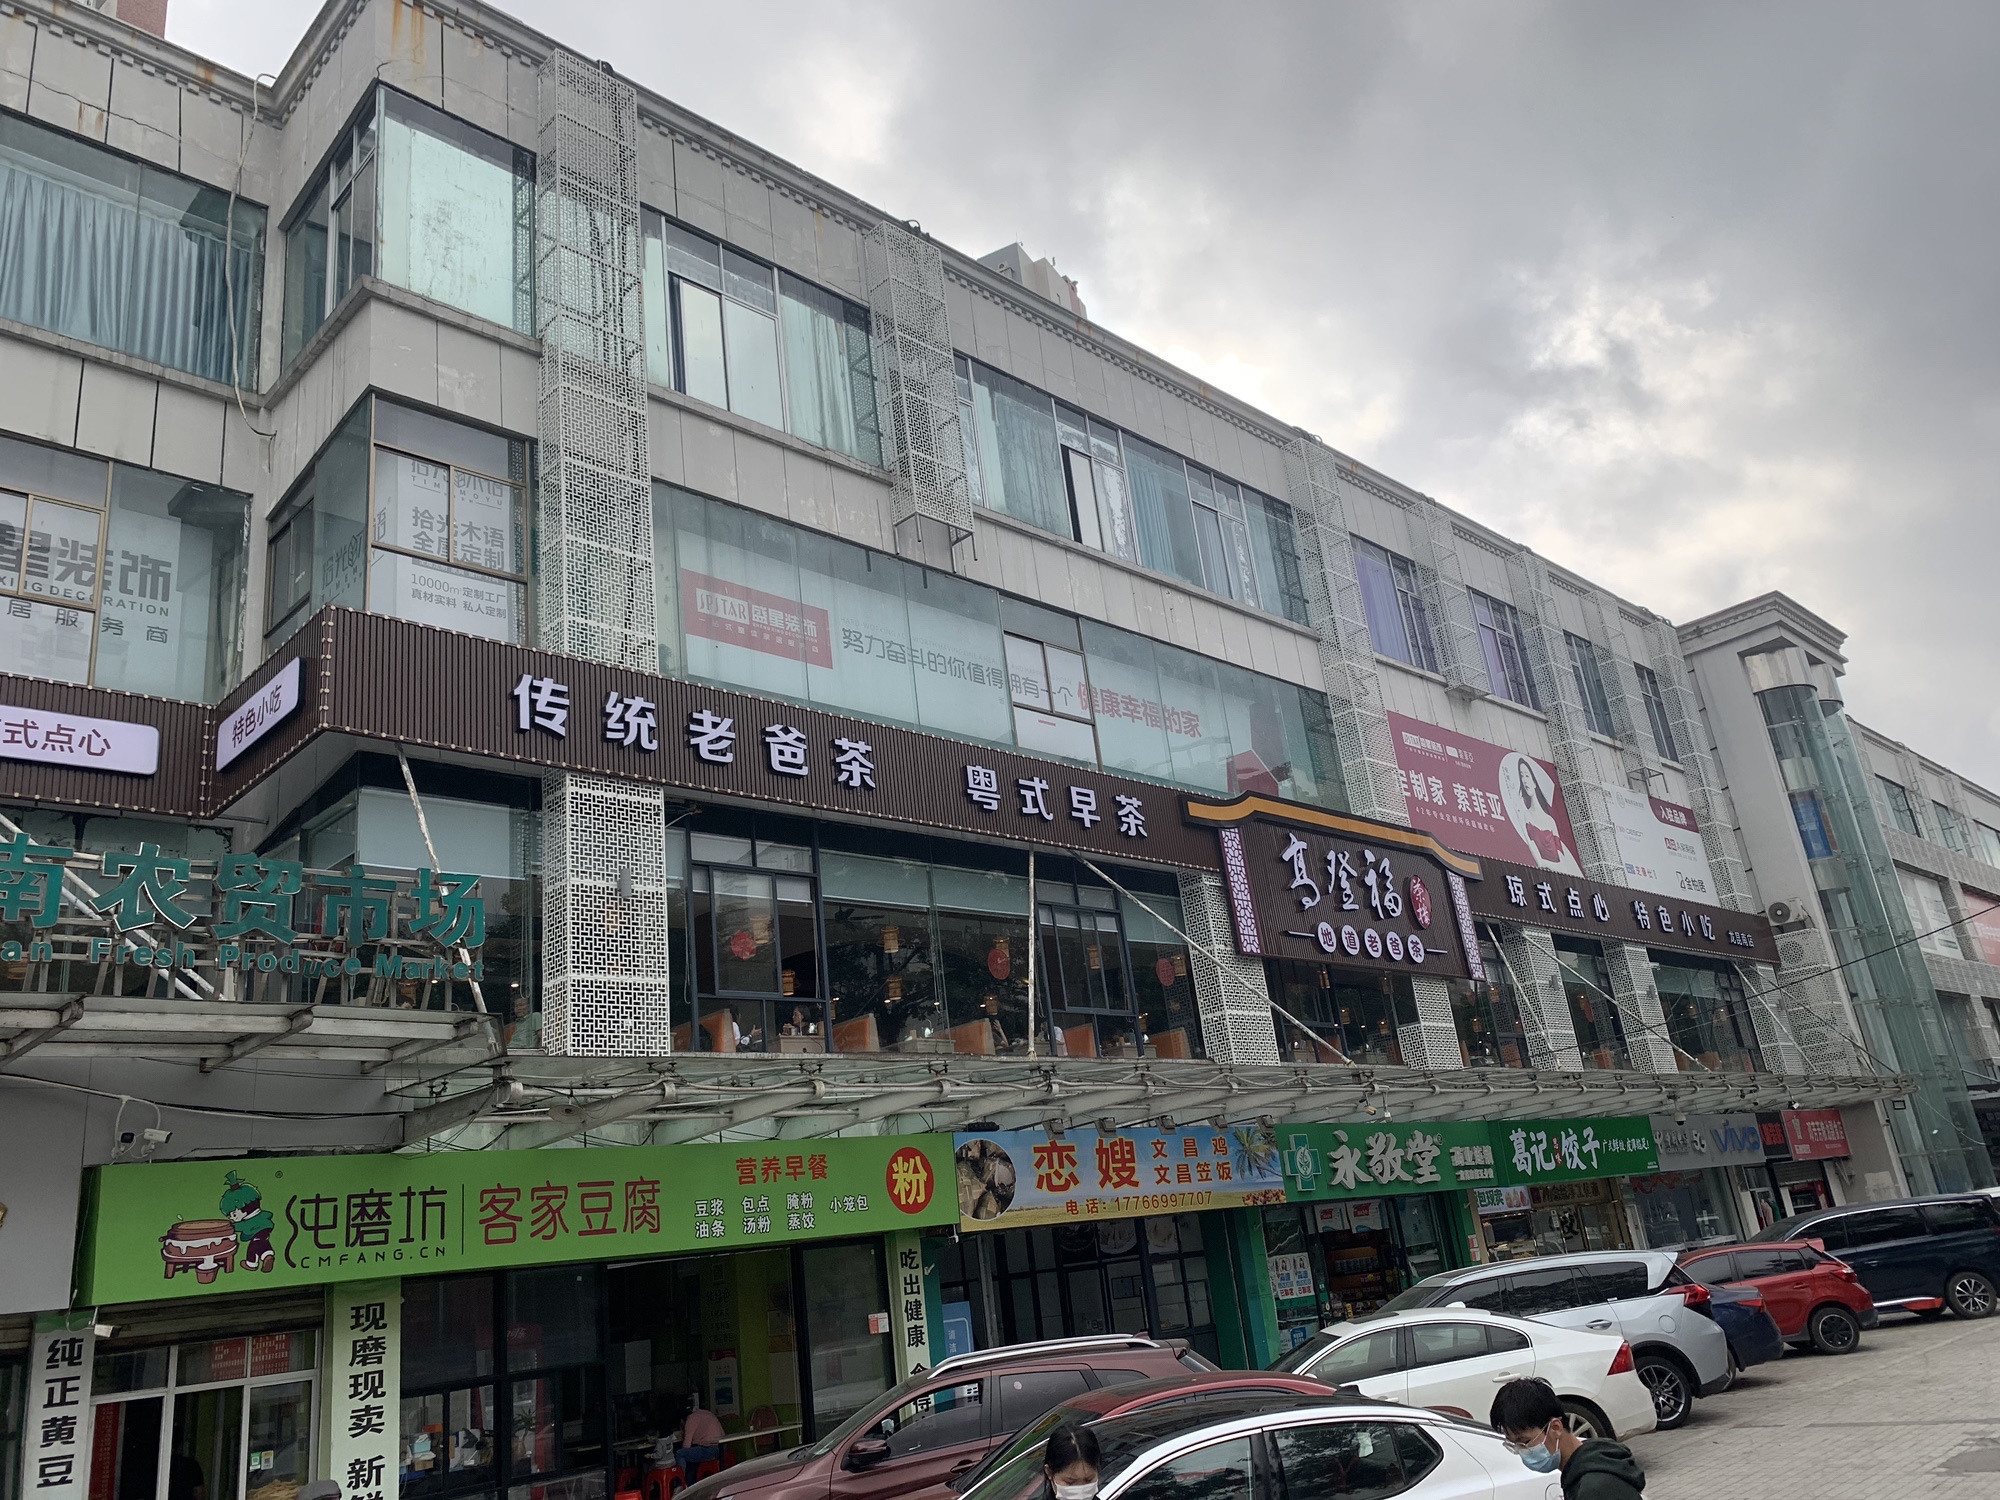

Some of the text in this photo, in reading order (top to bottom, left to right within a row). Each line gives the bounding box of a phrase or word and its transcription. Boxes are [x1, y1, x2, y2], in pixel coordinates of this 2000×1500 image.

[411, 587, 507, 620] 真材实料 私人定制
[751, 603, 818, 638] 盛星装饰
[231, 684, 283, 748] 特色小吃
[0, 718, 111, 758] 式点心
[513, 673, 1148, 838] 传统老爸茶 粤式早茶
[1452, 782, 1506, 822] 索菲亚
[1659, 805, 1688, 827] 入驻品牌
[0, 831, 487, 949] 南农贸市场
[1505, 873, 1611, 922] 琼式点心
[1633, 899, 1716, 942] 特色小吃
[89, 937, 196, 970] Fresh
[219, 944, 361, 976] Produce
[375, 953, 485, 981] Market
[1319, 925, 1424, 960] 地道老爸茶
[1032, 1136, 1140, 1194] 恋嫂
[1150, 1136, 1229, 1160] 文昌鸡
[1326, 1129, 1442, 1190] 永敬堂
[735, 1153, 829, 1186] 营养早餐
[891, 1155, 928, 1206] 粉
[1154, 1161, 1233, 1186] 文昌笠饭
[478, 1175, 662, 1246] 客家豆腐
[694, 1191, 869, 1218] 豆浆 包点 腌粉 小笼包
[1476, 1188, 1505, 1208] 包现卖
[284, 1185, 448, 1269] 纯磨坊
[694, 1212, 816, 1239] 油条 汤粉 蒸饺
[300, 1245, 446, 1269] CMFANG.CN
[900, 1248, 926, 1348] 吃出健康
[348, 1302, 388, 1439] 现磨现卖
[36, 1337, 84, 1489] 纯正黄豆
